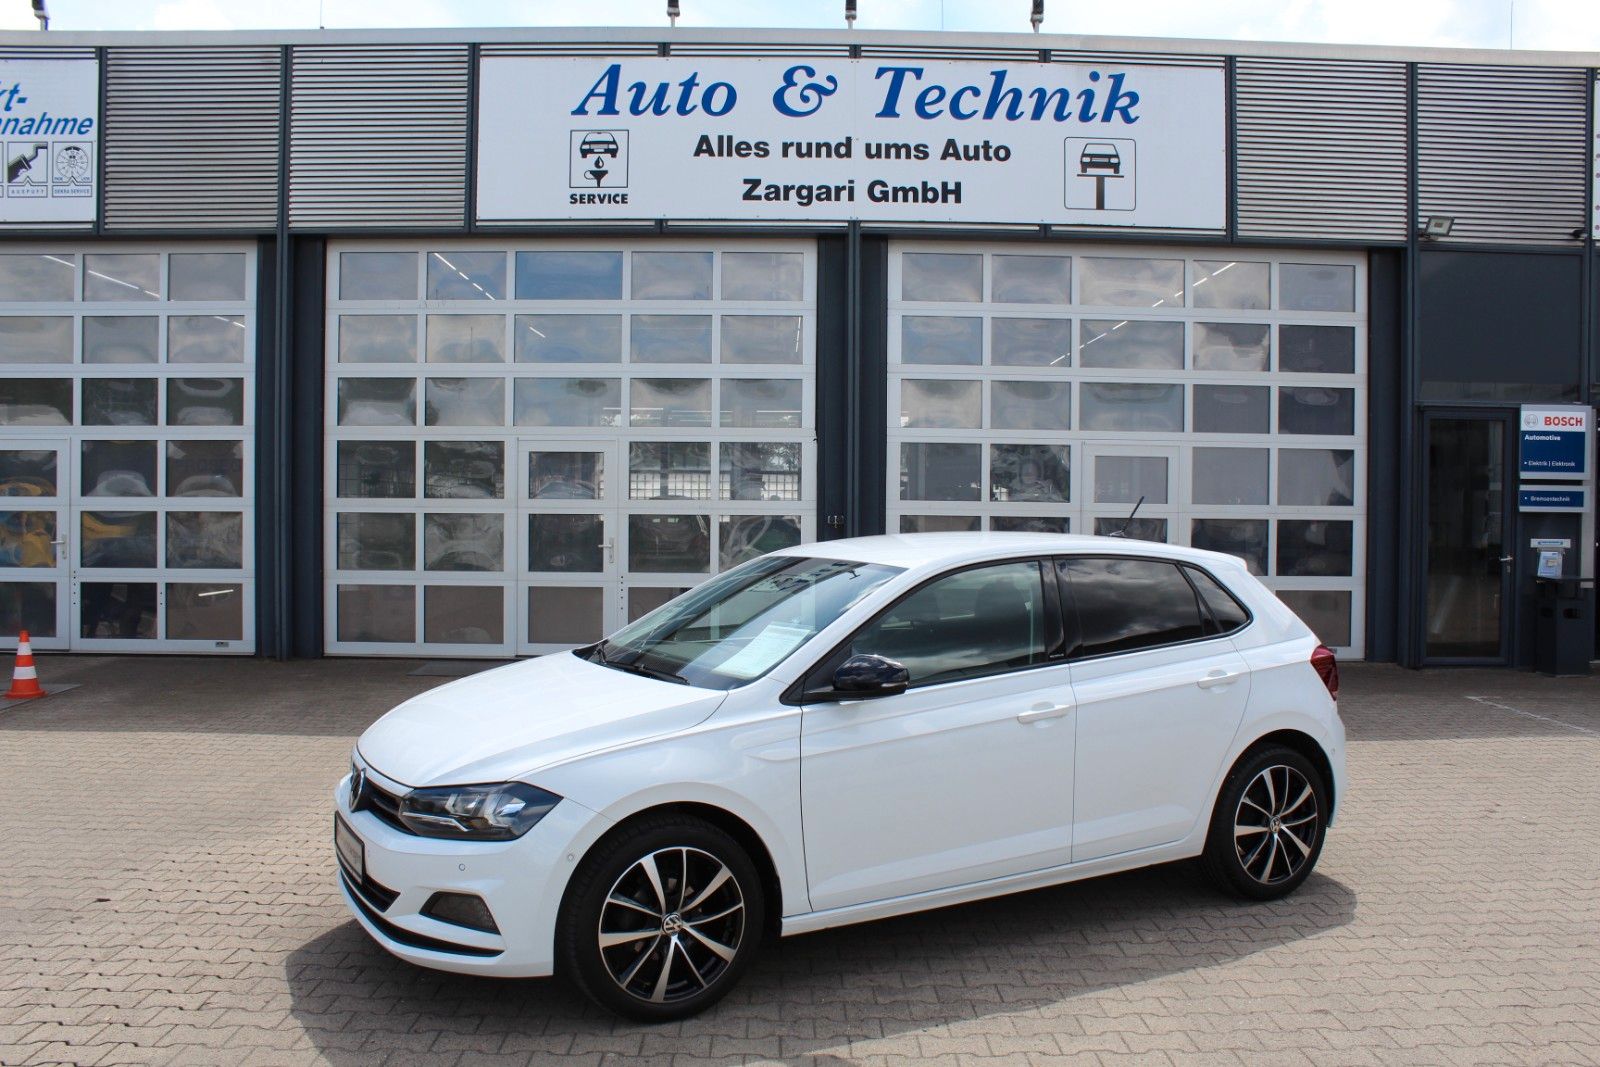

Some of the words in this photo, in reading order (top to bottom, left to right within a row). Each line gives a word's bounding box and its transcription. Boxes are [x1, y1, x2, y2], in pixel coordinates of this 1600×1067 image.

[570, 64, 738, 117] Auto
[772, 65, 838, 118] &
[874, 66, 1141, 125] Technik
[0, 111, 93, 135] nahme
[693, 134, 770, 158] Alles
[781, 136, 852, 159] rund
[865, 142, 930, 160] ums
[940, 138, 1011, 162] Auto
[569, 193, 629, 204] SERVICE
[742, 178, 855, 207] Zargari
[867, 179, 962, 204] GmbH
[1544, 416, 1583, 427] BOSCH
